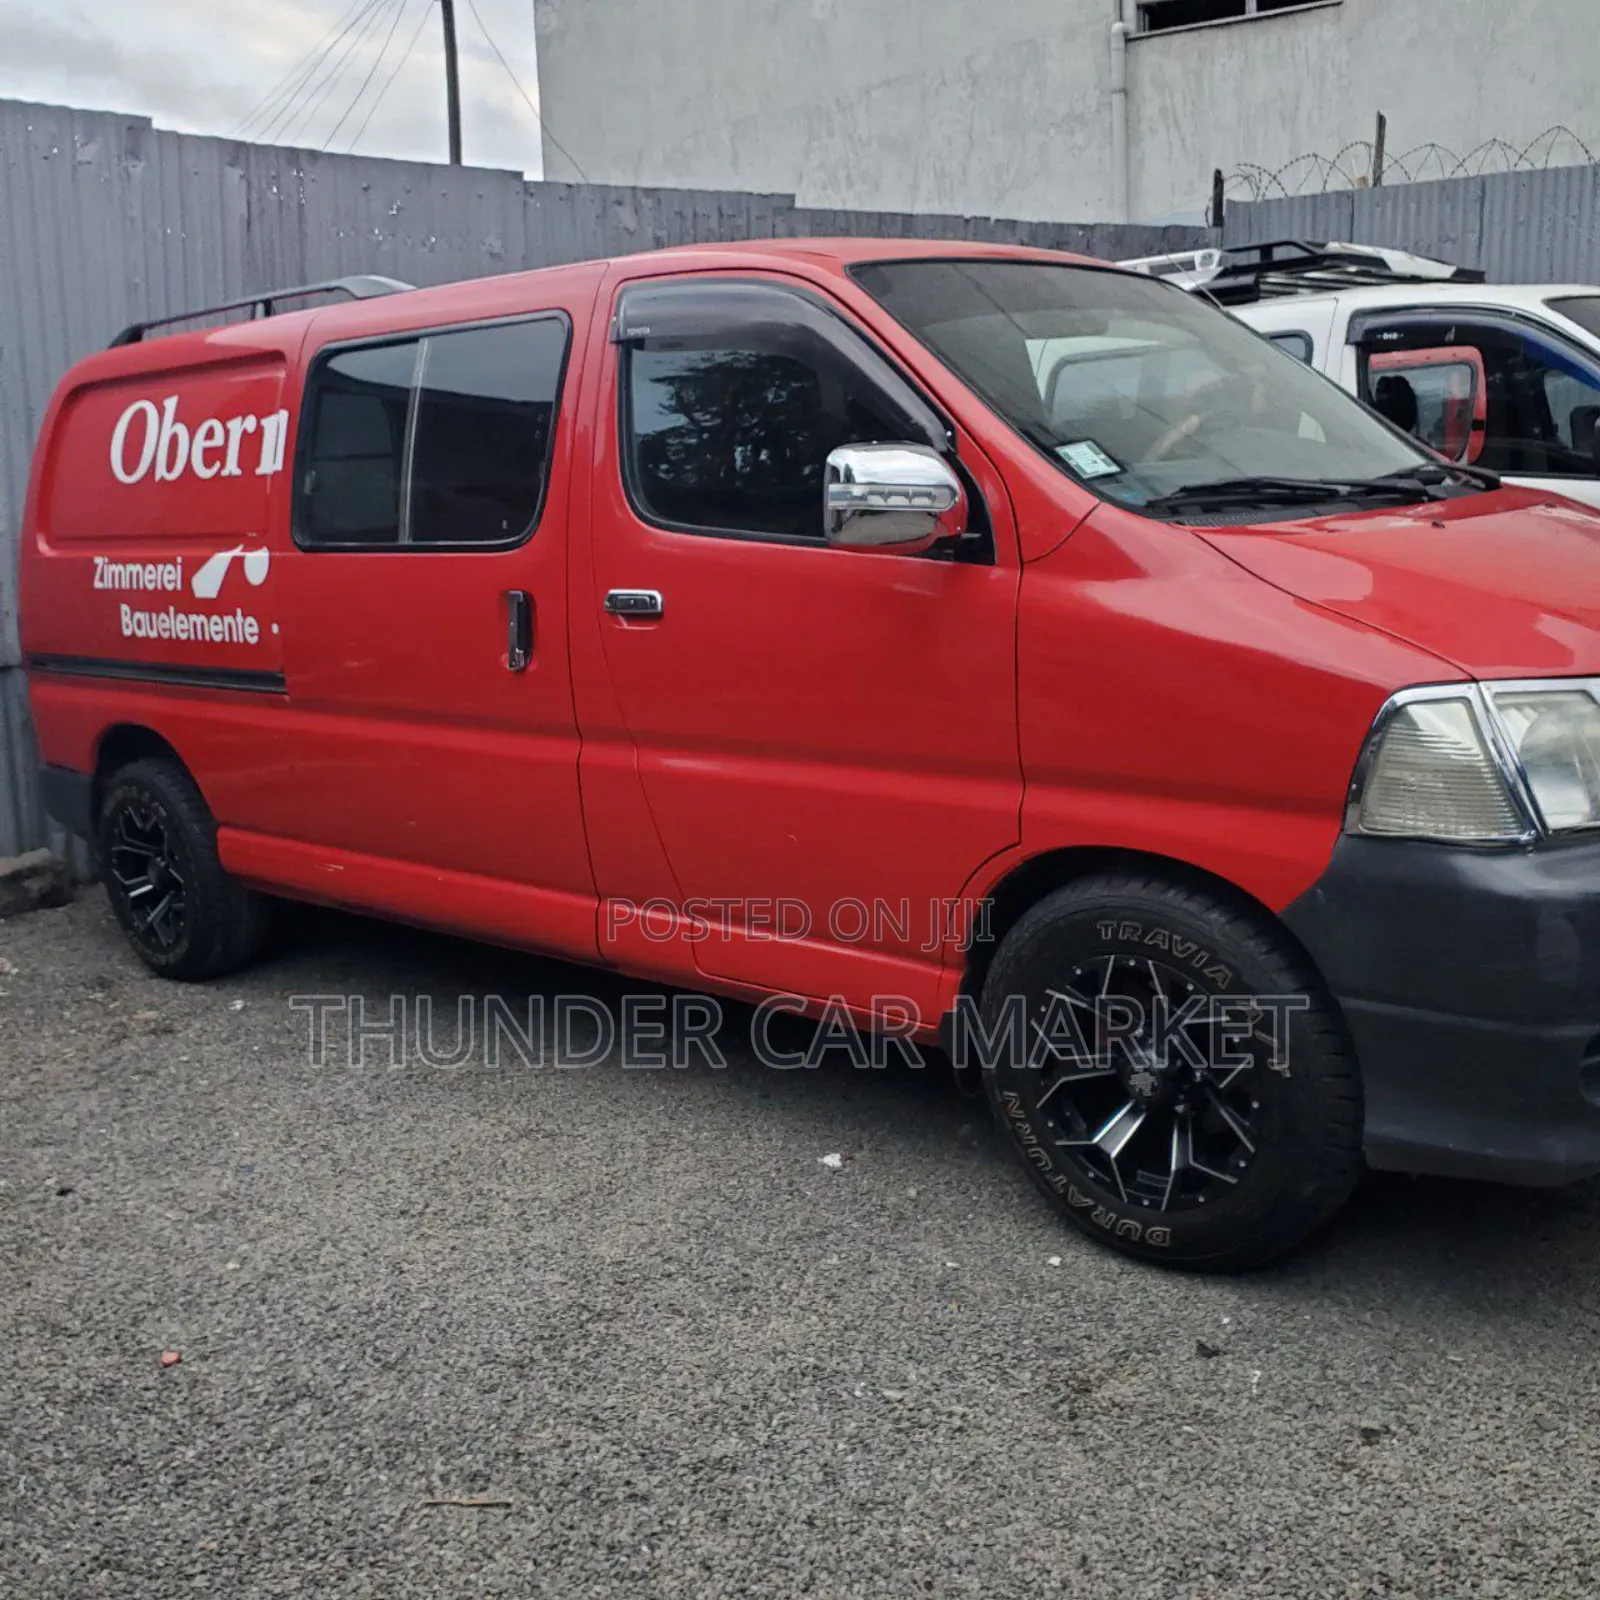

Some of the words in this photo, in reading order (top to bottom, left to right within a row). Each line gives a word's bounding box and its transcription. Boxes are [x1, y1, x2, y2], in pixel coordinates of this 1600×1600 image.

[93, 556, 182, 591] Zimmerei
[120, 602, 260, 644] Bauelemente
[1097, 920, 1233, 989] TRAVIA
[1003, 1091, 1171, 1247] DURATURN
